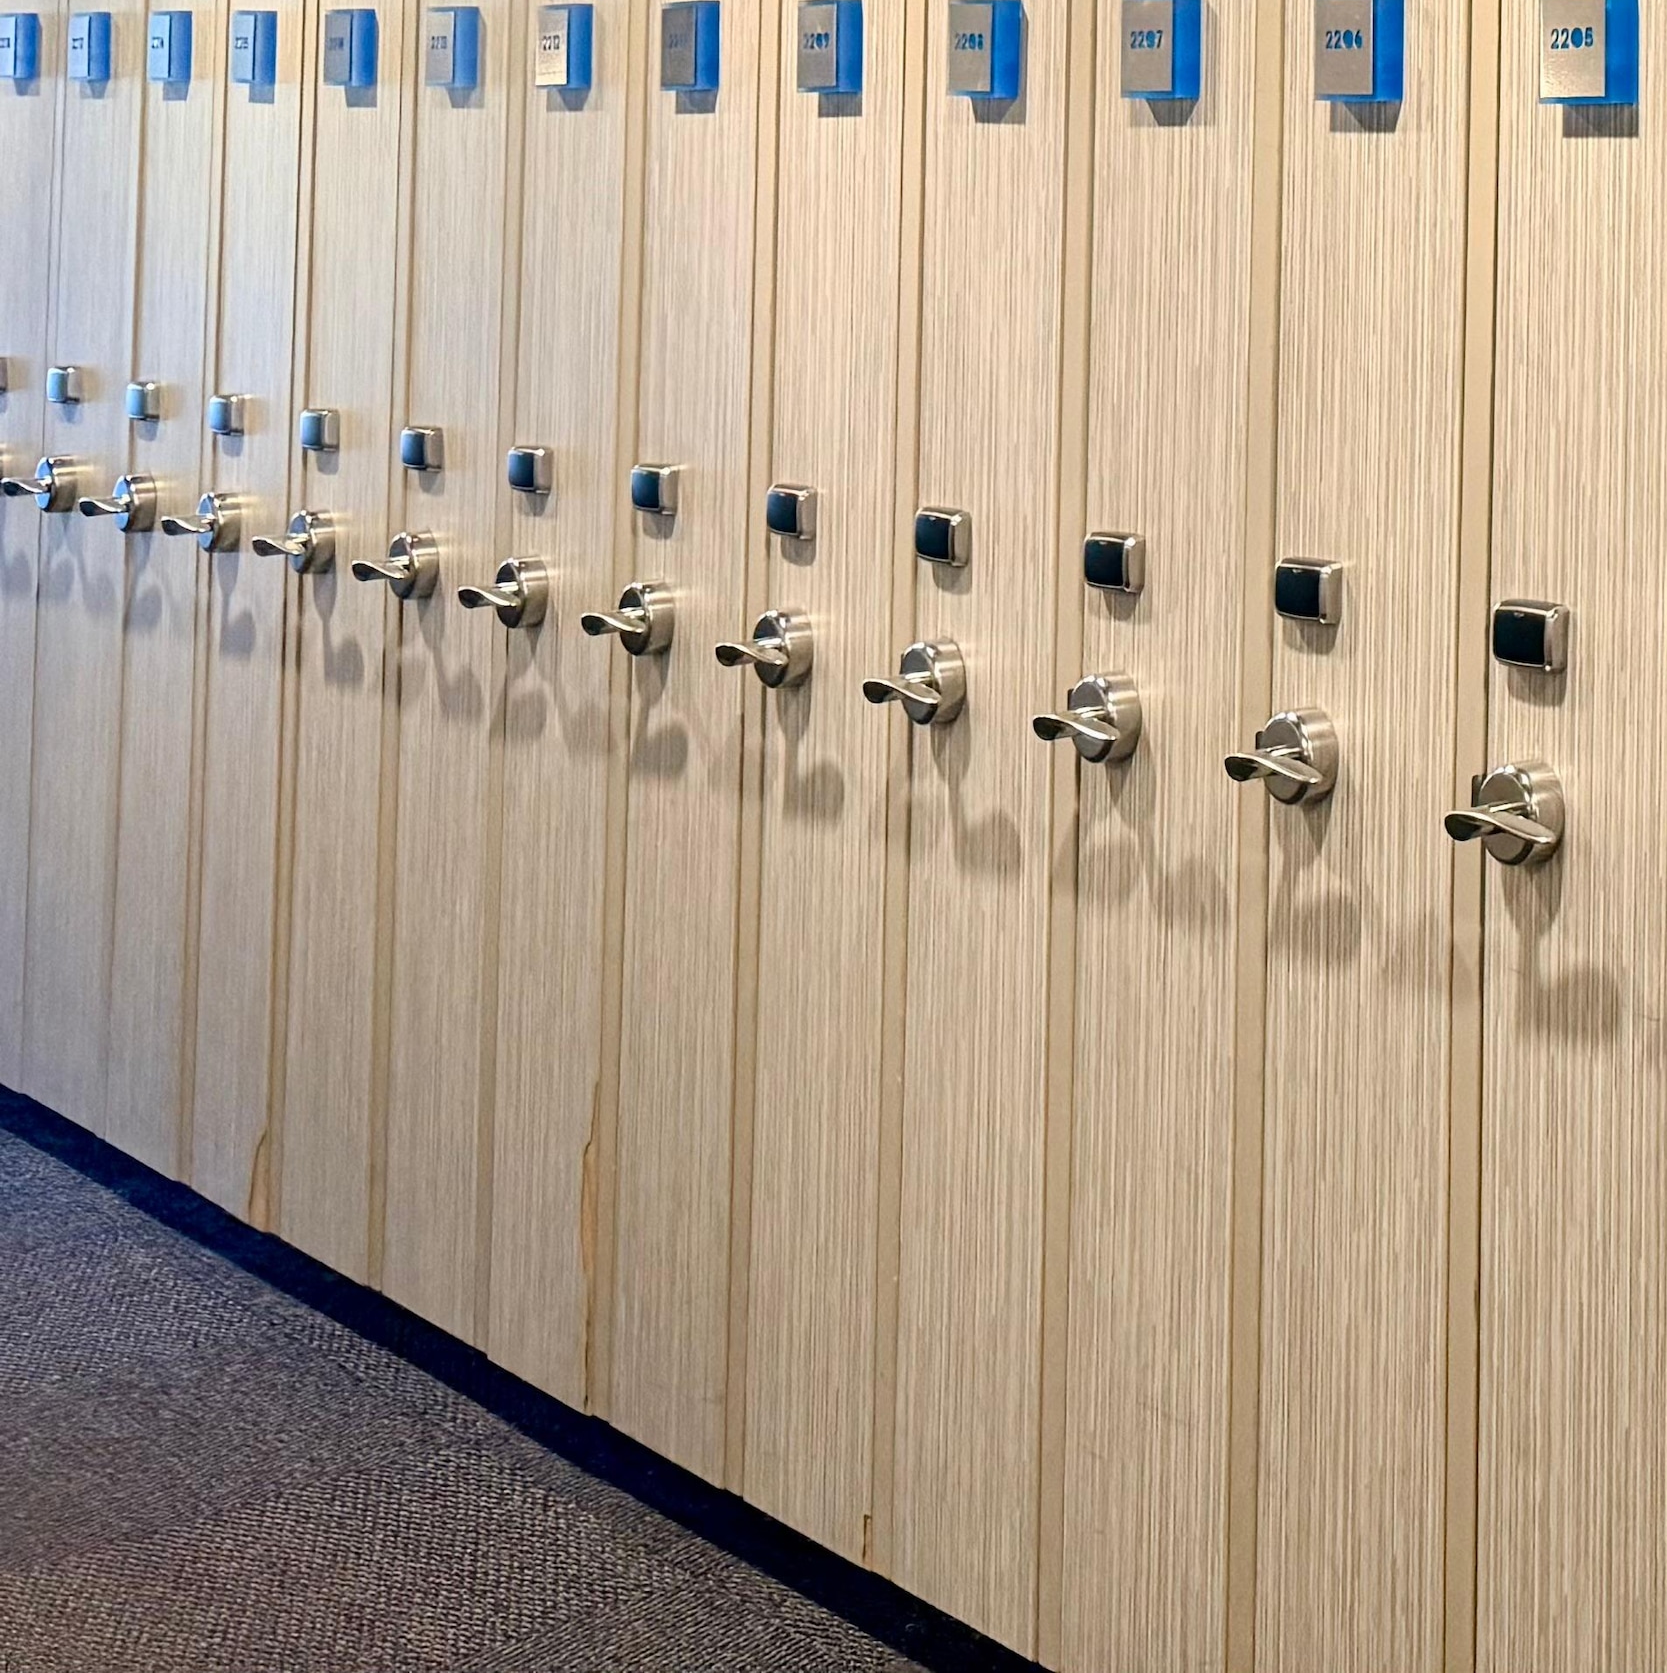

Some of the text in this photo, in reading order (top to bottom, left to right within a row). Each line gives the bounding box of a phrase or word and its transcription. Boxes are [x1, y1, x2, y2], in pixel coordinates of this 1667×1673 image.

[1130, 30, 1163, 50] 2207
[1325, 29, 1363, 49] 2206
[1550, 26, 1594, 49] 2205
